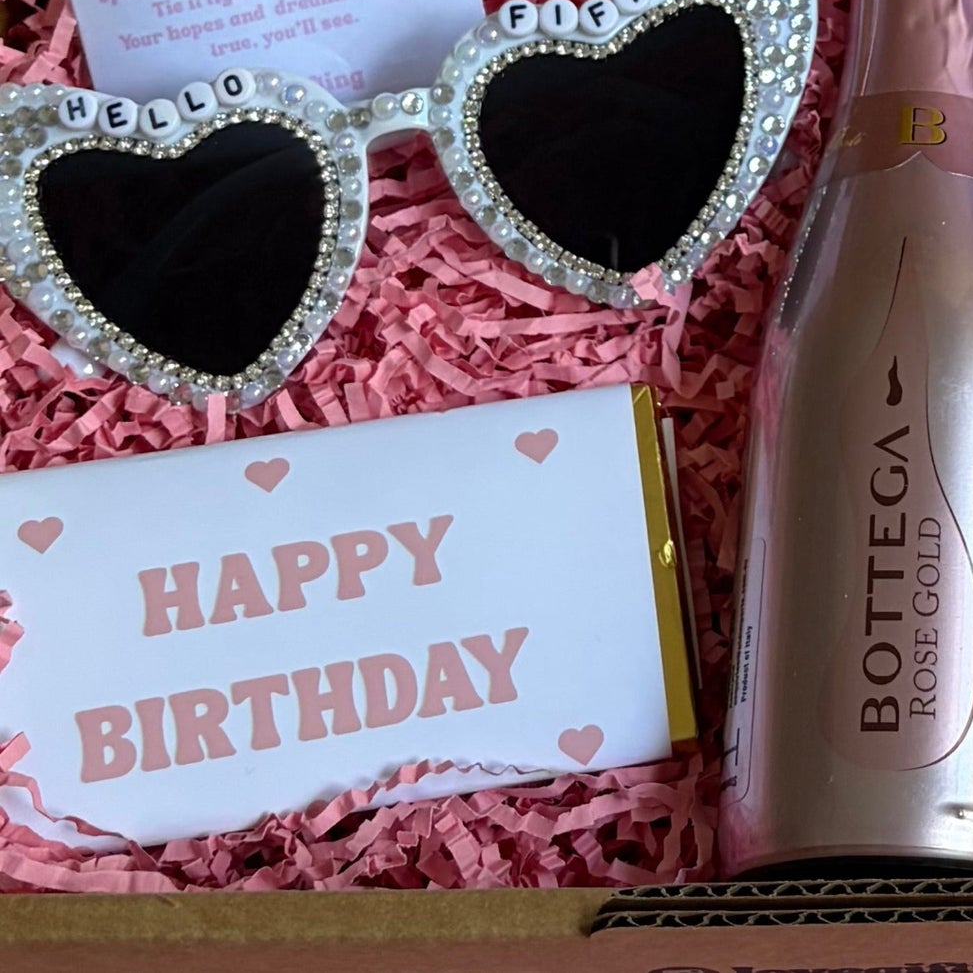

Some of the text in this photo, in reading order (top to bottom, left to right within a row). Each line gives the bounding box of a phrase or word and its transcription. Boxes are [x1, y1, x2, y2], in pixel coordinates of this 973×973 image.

[118, 31, 164, 52] Your
[167, 18, 225, 43] hopes
[229, 4, 265, 27] and
[152, 0, 184, 18] Tie
[262, 18, 317, 49] you'll
[66, 74, 243, 129] HELLO
[900, 104, 947, 146] B
[137, 514, 454, 637] HAPPY
[909, 516, 943, 720] ROSE GOLD
[74, 627, 530, 783] BIRTHDAY
[740, 663, 750, 703] Product
